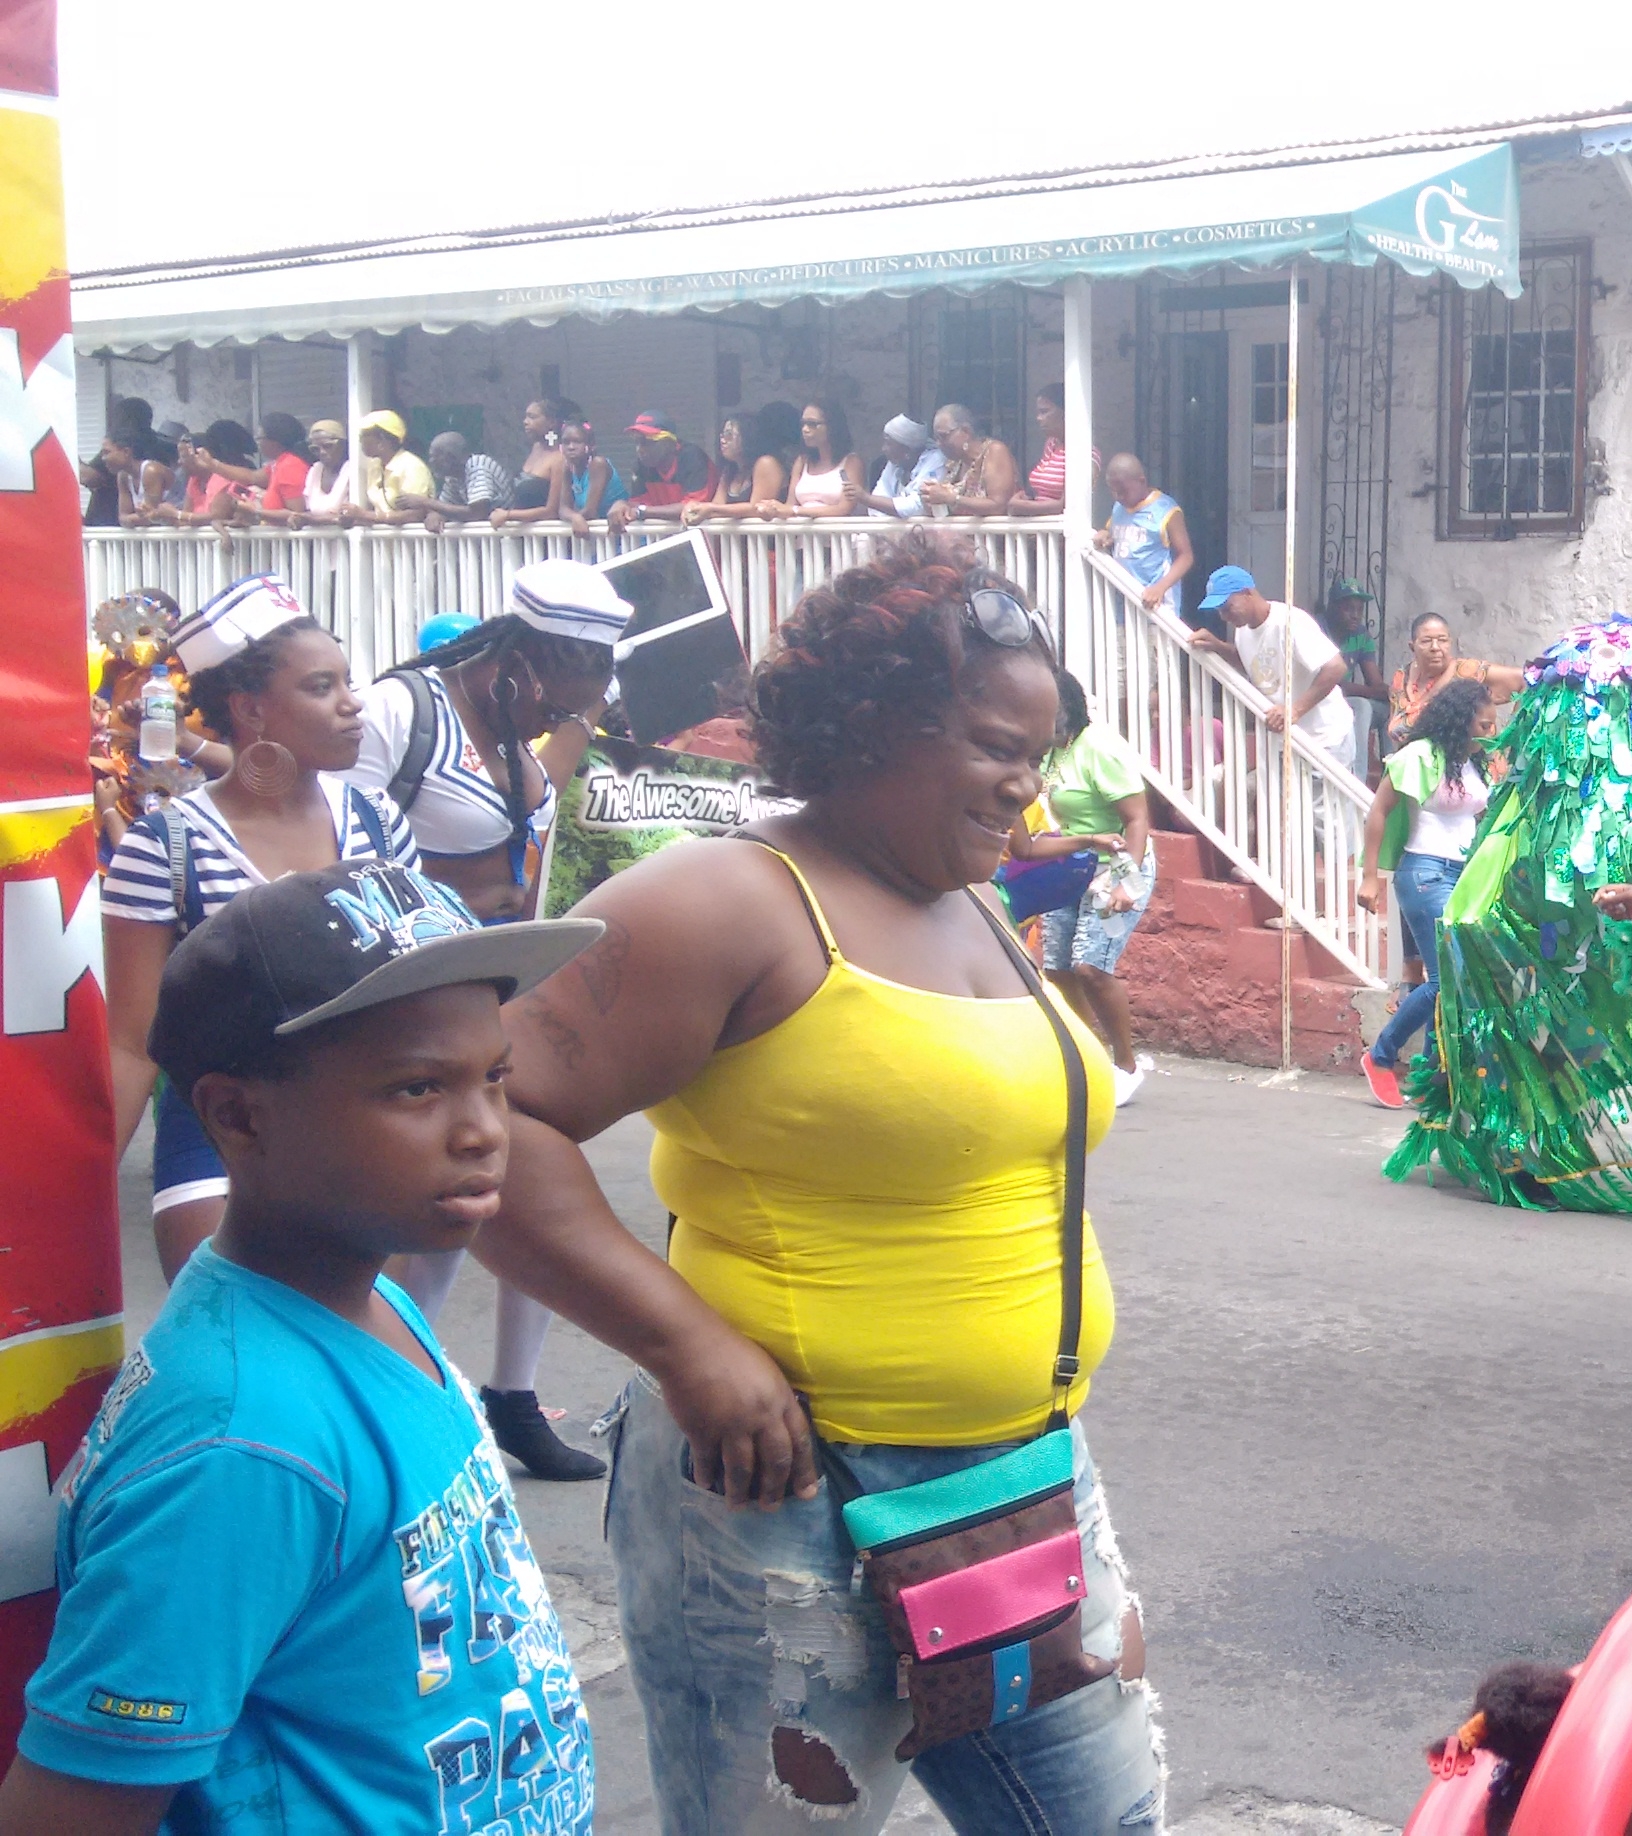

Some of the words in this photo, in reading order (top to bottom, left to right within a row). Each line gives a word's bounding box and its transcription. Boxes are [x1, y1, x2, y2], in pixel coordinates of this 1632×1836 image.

[505, 285, 576, 303] FACIALS
[585, 278, 676, 298] MASSAGE
[686, 269, 769, 289] WAXING
[779, 258, 900, 281] PEDICURES
[914, 243, 1052, 271] MANICURES
[1065, 232, 1168, 257] ACRYLIC
[1184, 218, 1303, 244] COSMETICS
[1376, 234, 1433, 261] HEALTH
[1445, 252, 1497, 277] BEAUTY
[586, 774, 631, 823] The
[631, 773, 737, 825] Awesome
